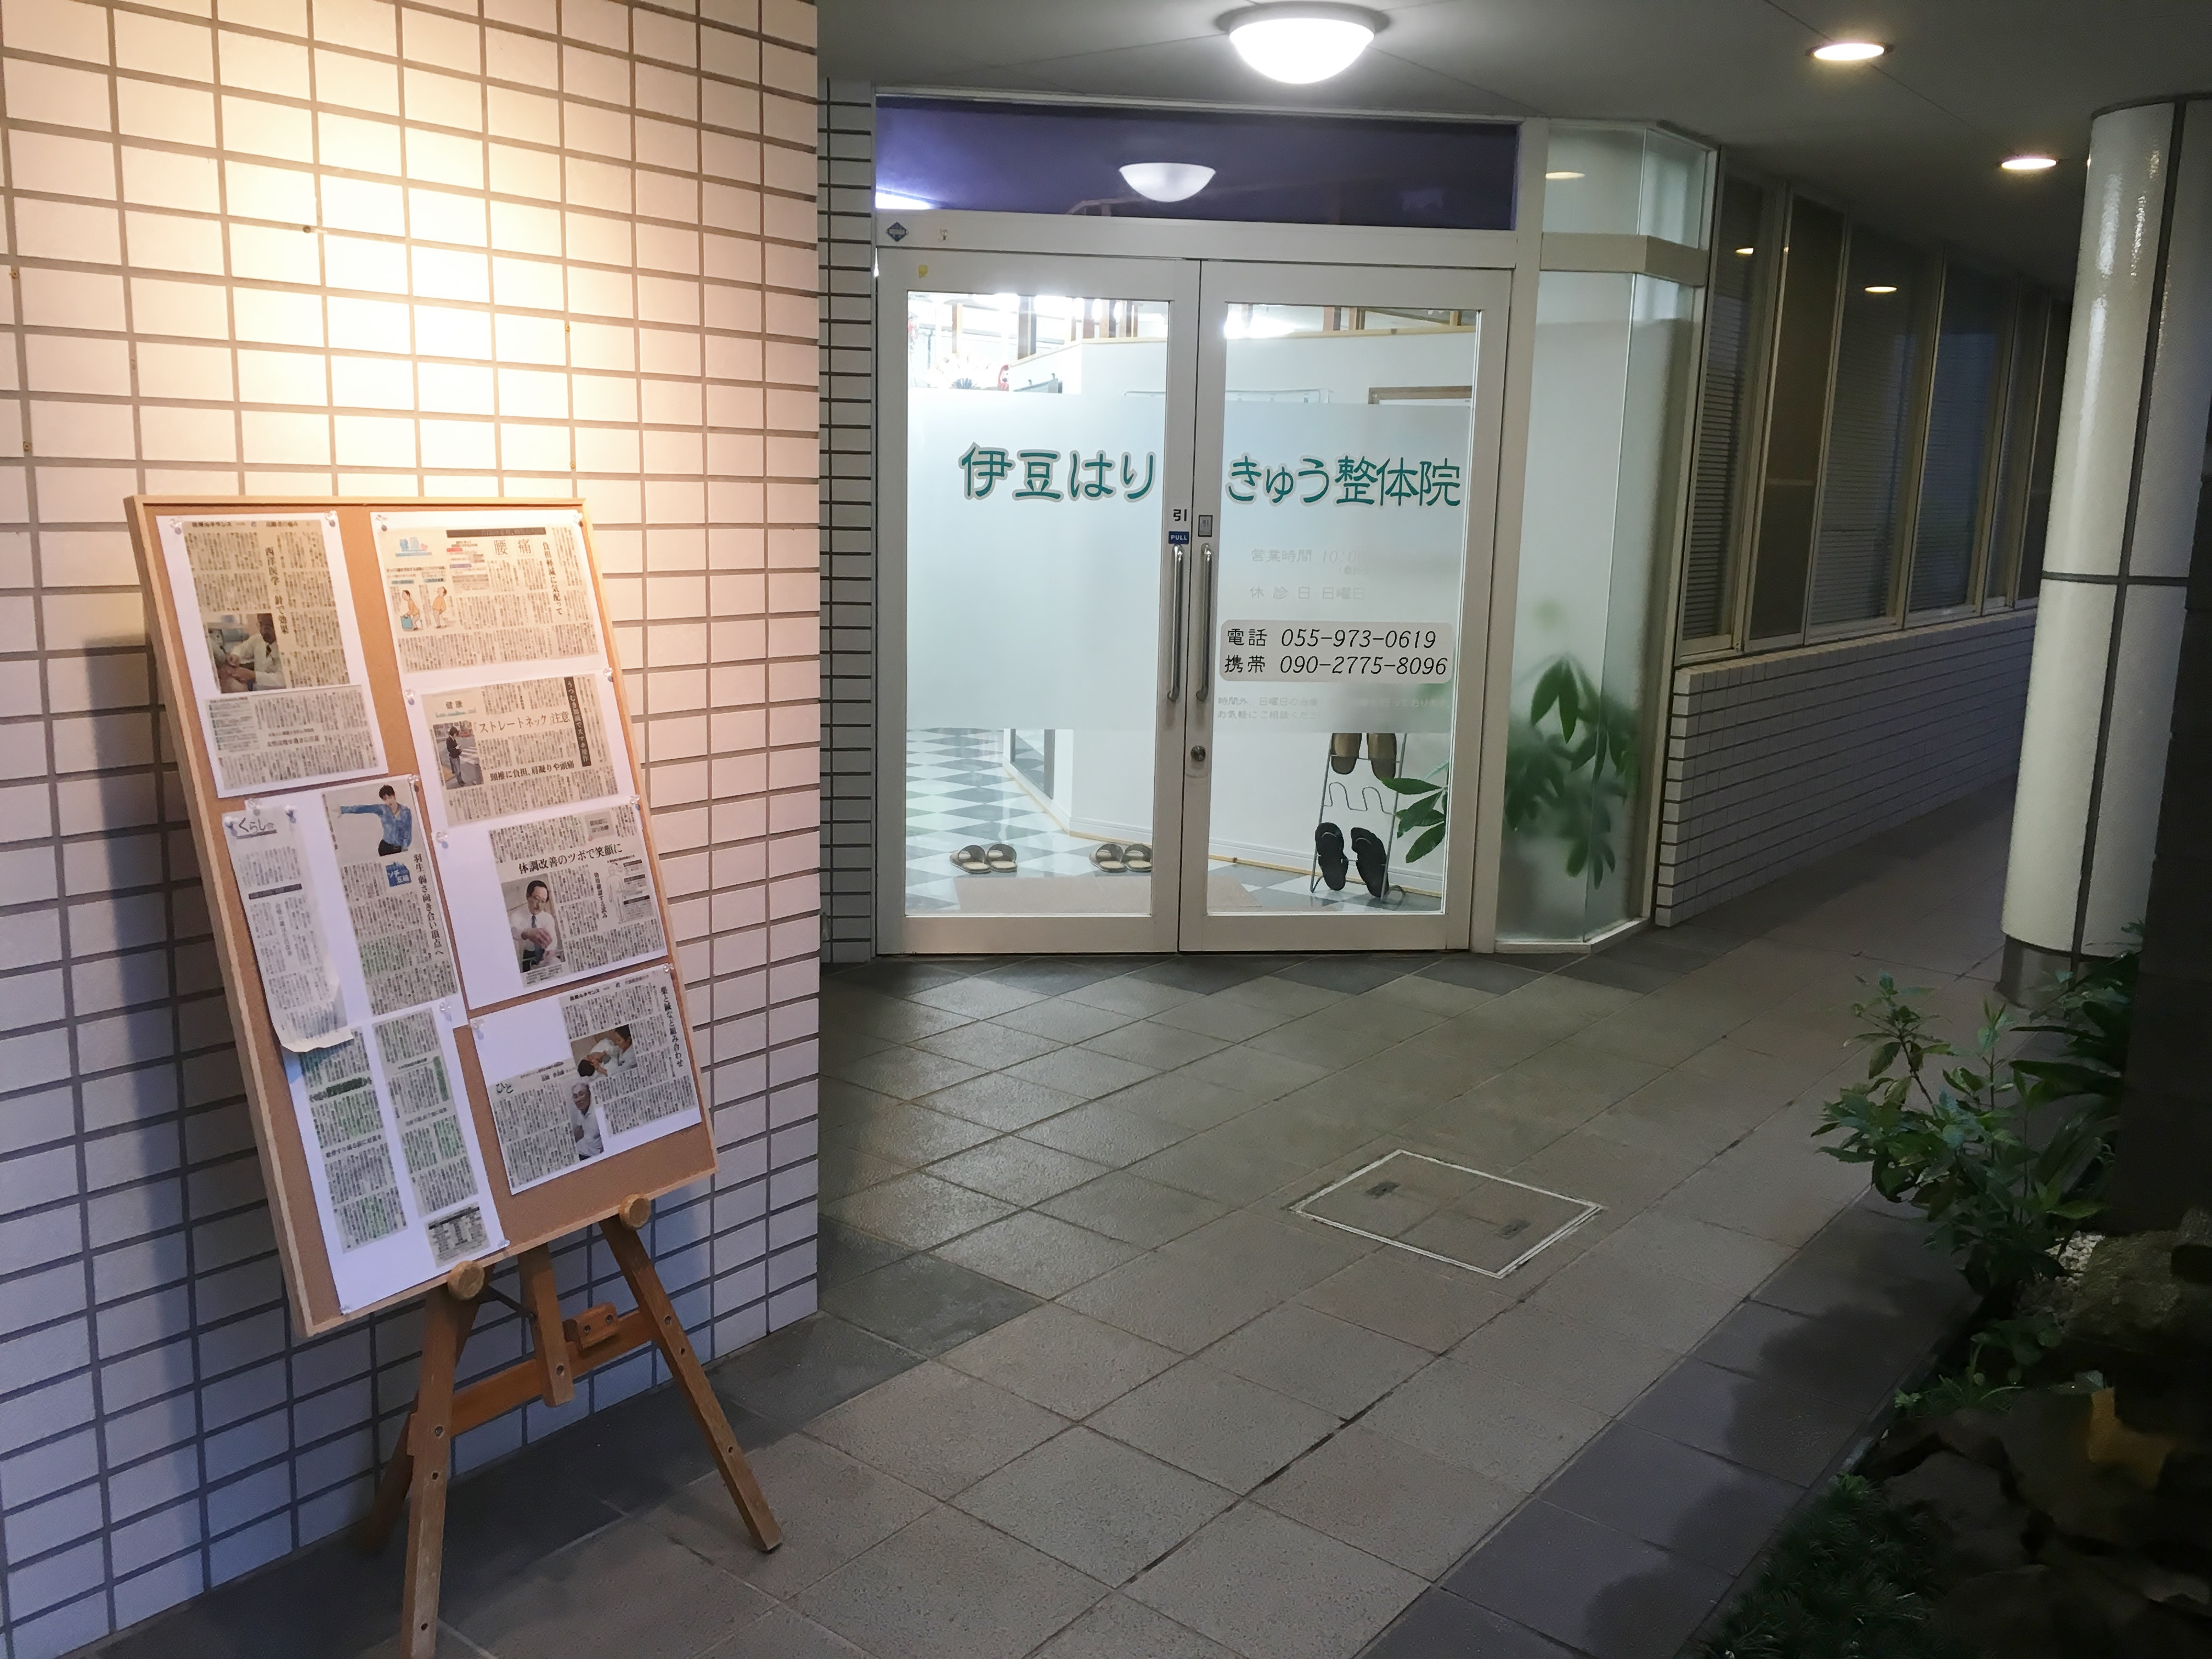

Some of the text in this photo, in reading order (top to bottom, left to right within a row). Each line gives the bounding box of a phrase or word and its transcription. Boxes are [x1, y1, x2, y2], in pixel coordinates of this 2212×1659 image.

[960, 444, 1462, 507] 伊豆はり きゅう整体院
[1173, 509, 1187, 522] 引
[1251, 549, 1312, 563] 営業時間
[1250, 586, 1365, 600] 休診日 日曜日
[1227, 628, 1436, 649] 電話 055-973-0619
[1224, 654, 1448, 675] 携帯 090-2775-8096
[518, 843, 623, 874] 体調改善のツボで笑顔に
[495, 1082, 514, 1094] ひと
